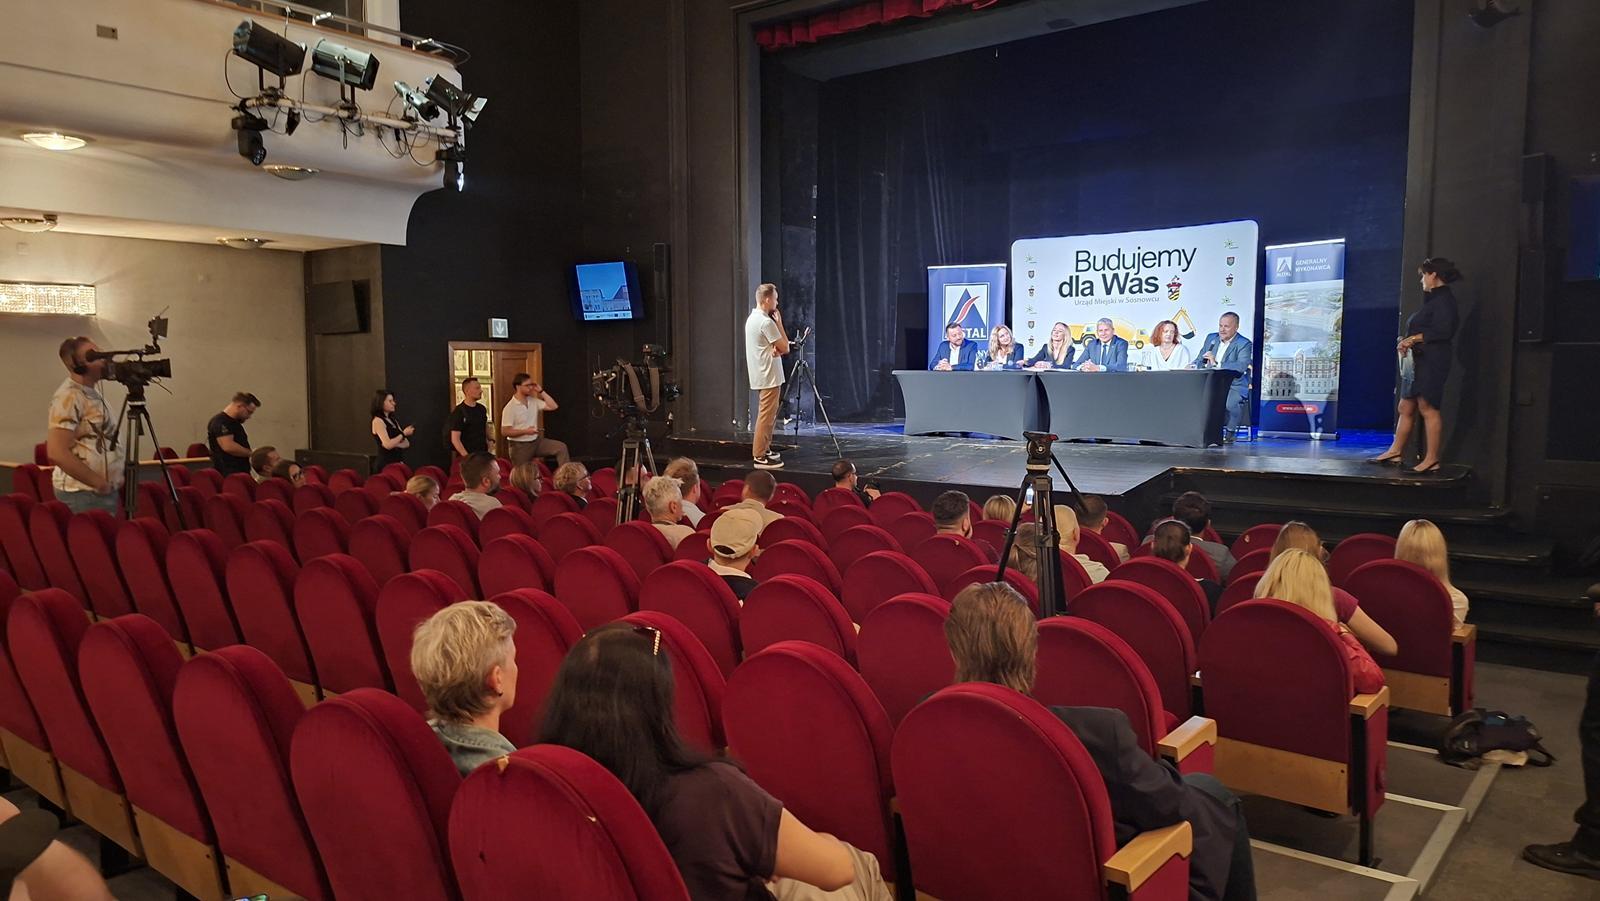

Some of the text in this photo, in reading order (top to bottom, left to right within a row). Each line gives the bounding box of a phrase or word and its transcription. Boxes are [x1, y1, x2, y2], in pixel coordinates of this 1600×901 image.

[1075, 246, 1197, 276] Budujemy
[1058, 272, 1160, 298] dla Was
[1074, 298, 1093, 307] Urząd
[1094, 297, 1117, 306] Miejski
[1125, 296, 1160, 304] Sosnowcu
